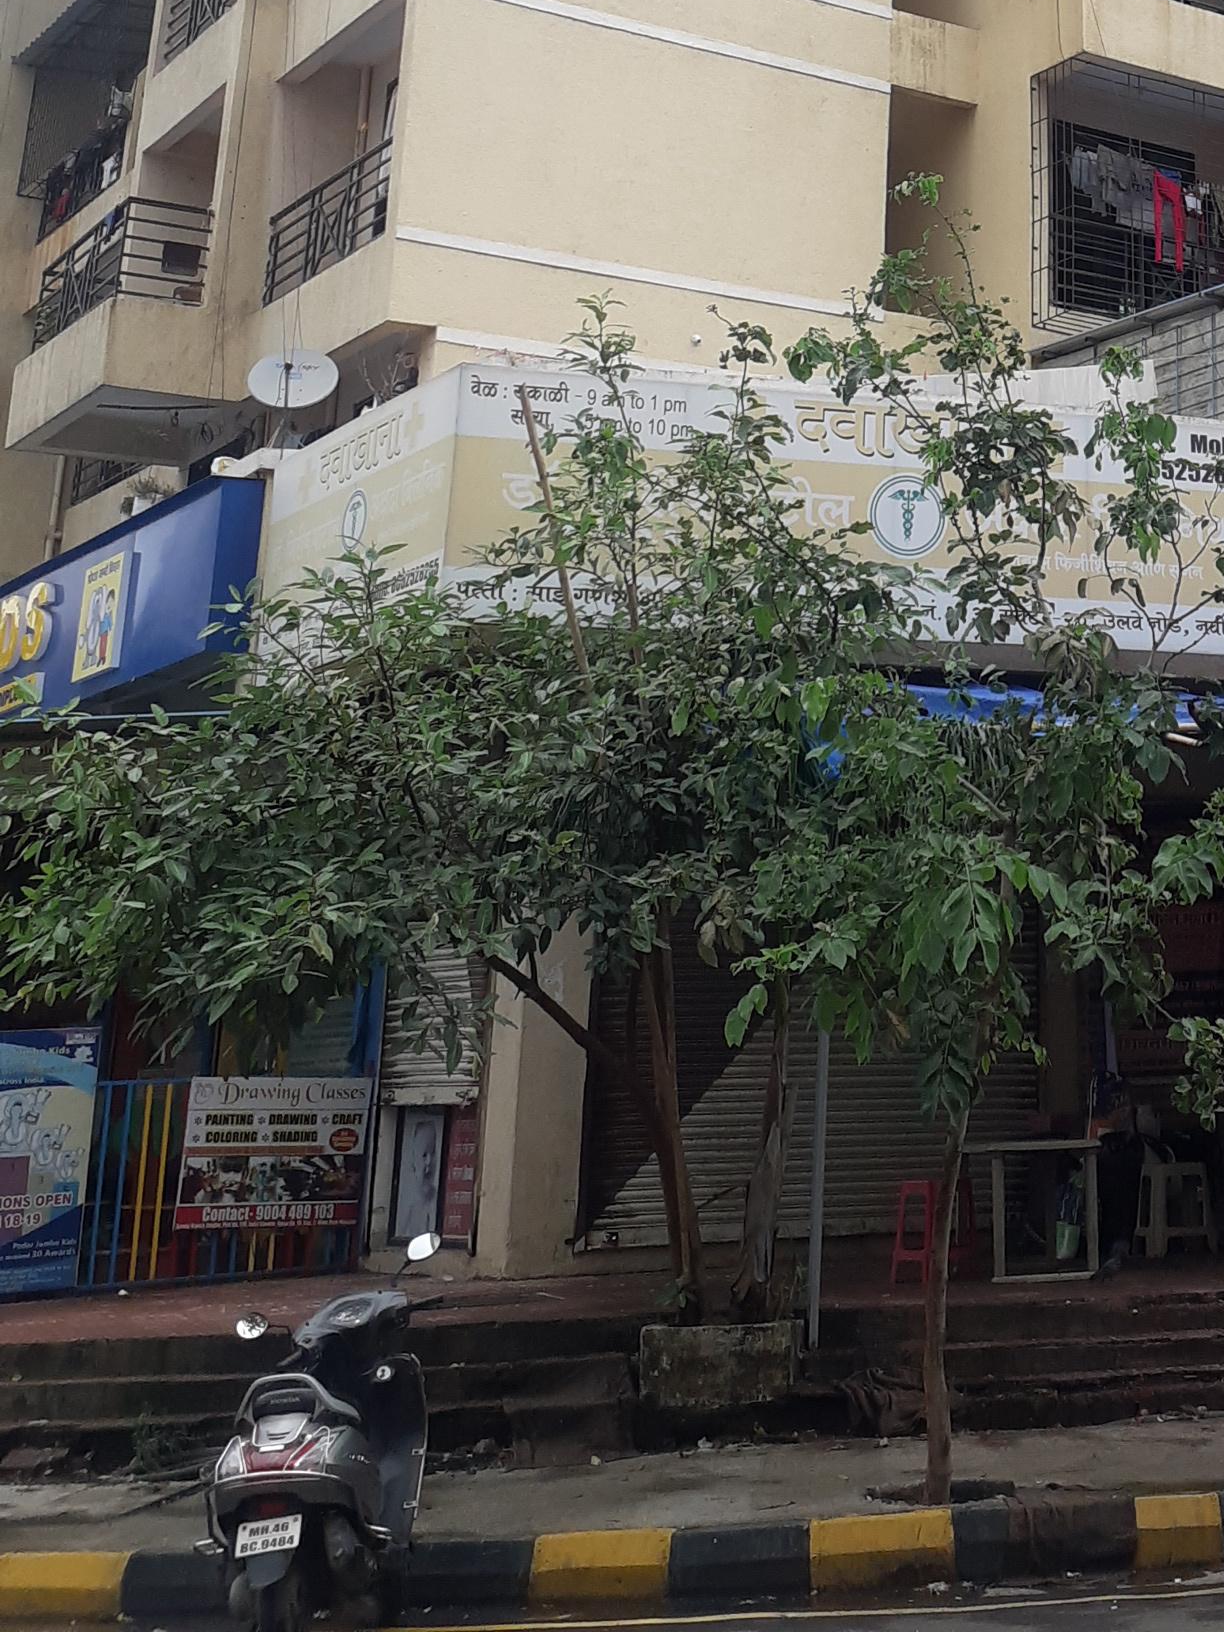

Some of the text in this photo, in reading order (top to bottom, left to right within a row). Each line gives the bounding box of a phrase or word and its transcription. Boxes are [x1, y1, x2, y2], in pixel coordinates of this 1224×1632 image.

[471, 374, 499, 399] वेळ
[587, 388, 597, 406] 9
[630, 393, 645, 410] to
[650, 394, 658, 411] 1
[664, 397, 687, 415] pm
[648, 419, 666, 436] 10
[218, 1082, 367, 1107] Drawing Classes
[205, 1113, 363, 1126] PAINTING DRAWING CRAFT
[205, 1131, 318, 1143] COLORING SHADING
[36, 1193, 72, 1207] OPEN
[256, 1206, 286, 1221] 9004
[288, 1204, 312, 1220] 489
[314, 1203, 334, 1219] 103
